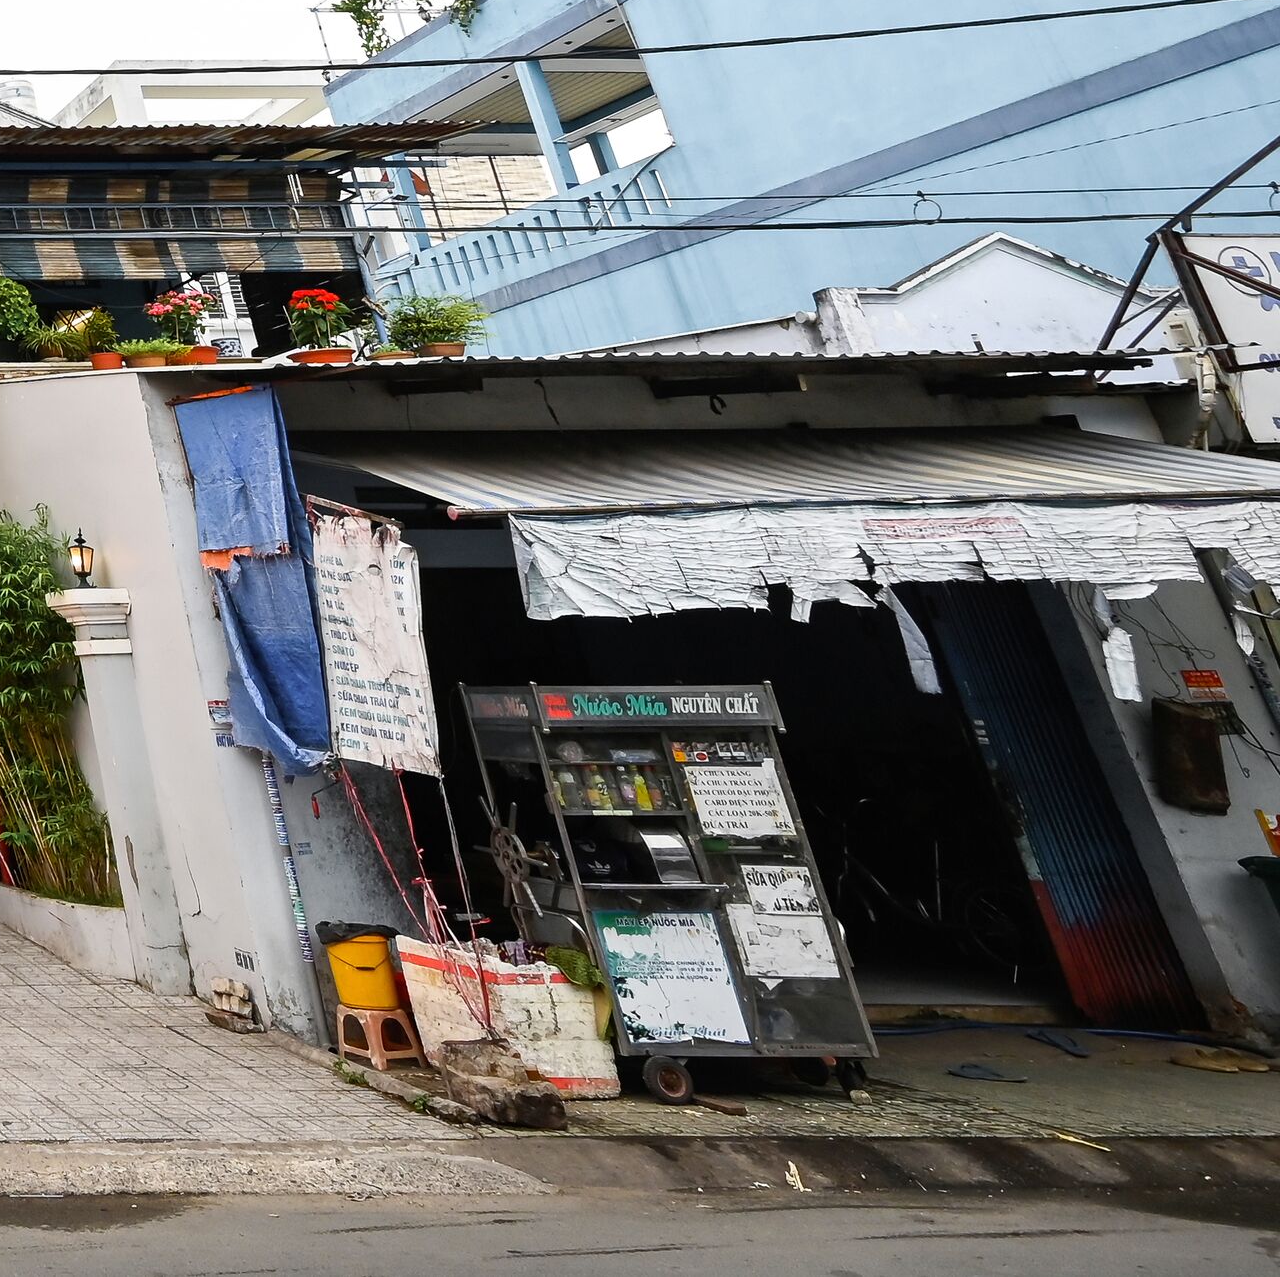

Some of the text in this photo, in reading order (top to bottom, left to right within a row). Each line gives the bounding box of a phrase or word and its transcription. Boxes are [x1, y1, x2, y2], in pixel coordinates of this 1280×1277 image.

[573, 693, 623, 716] Nước
[627, 693, 667, 716] Mía
[671, 693, 721, 714] NGUYÊN
[726, 692, 758, 714] CHẤT
